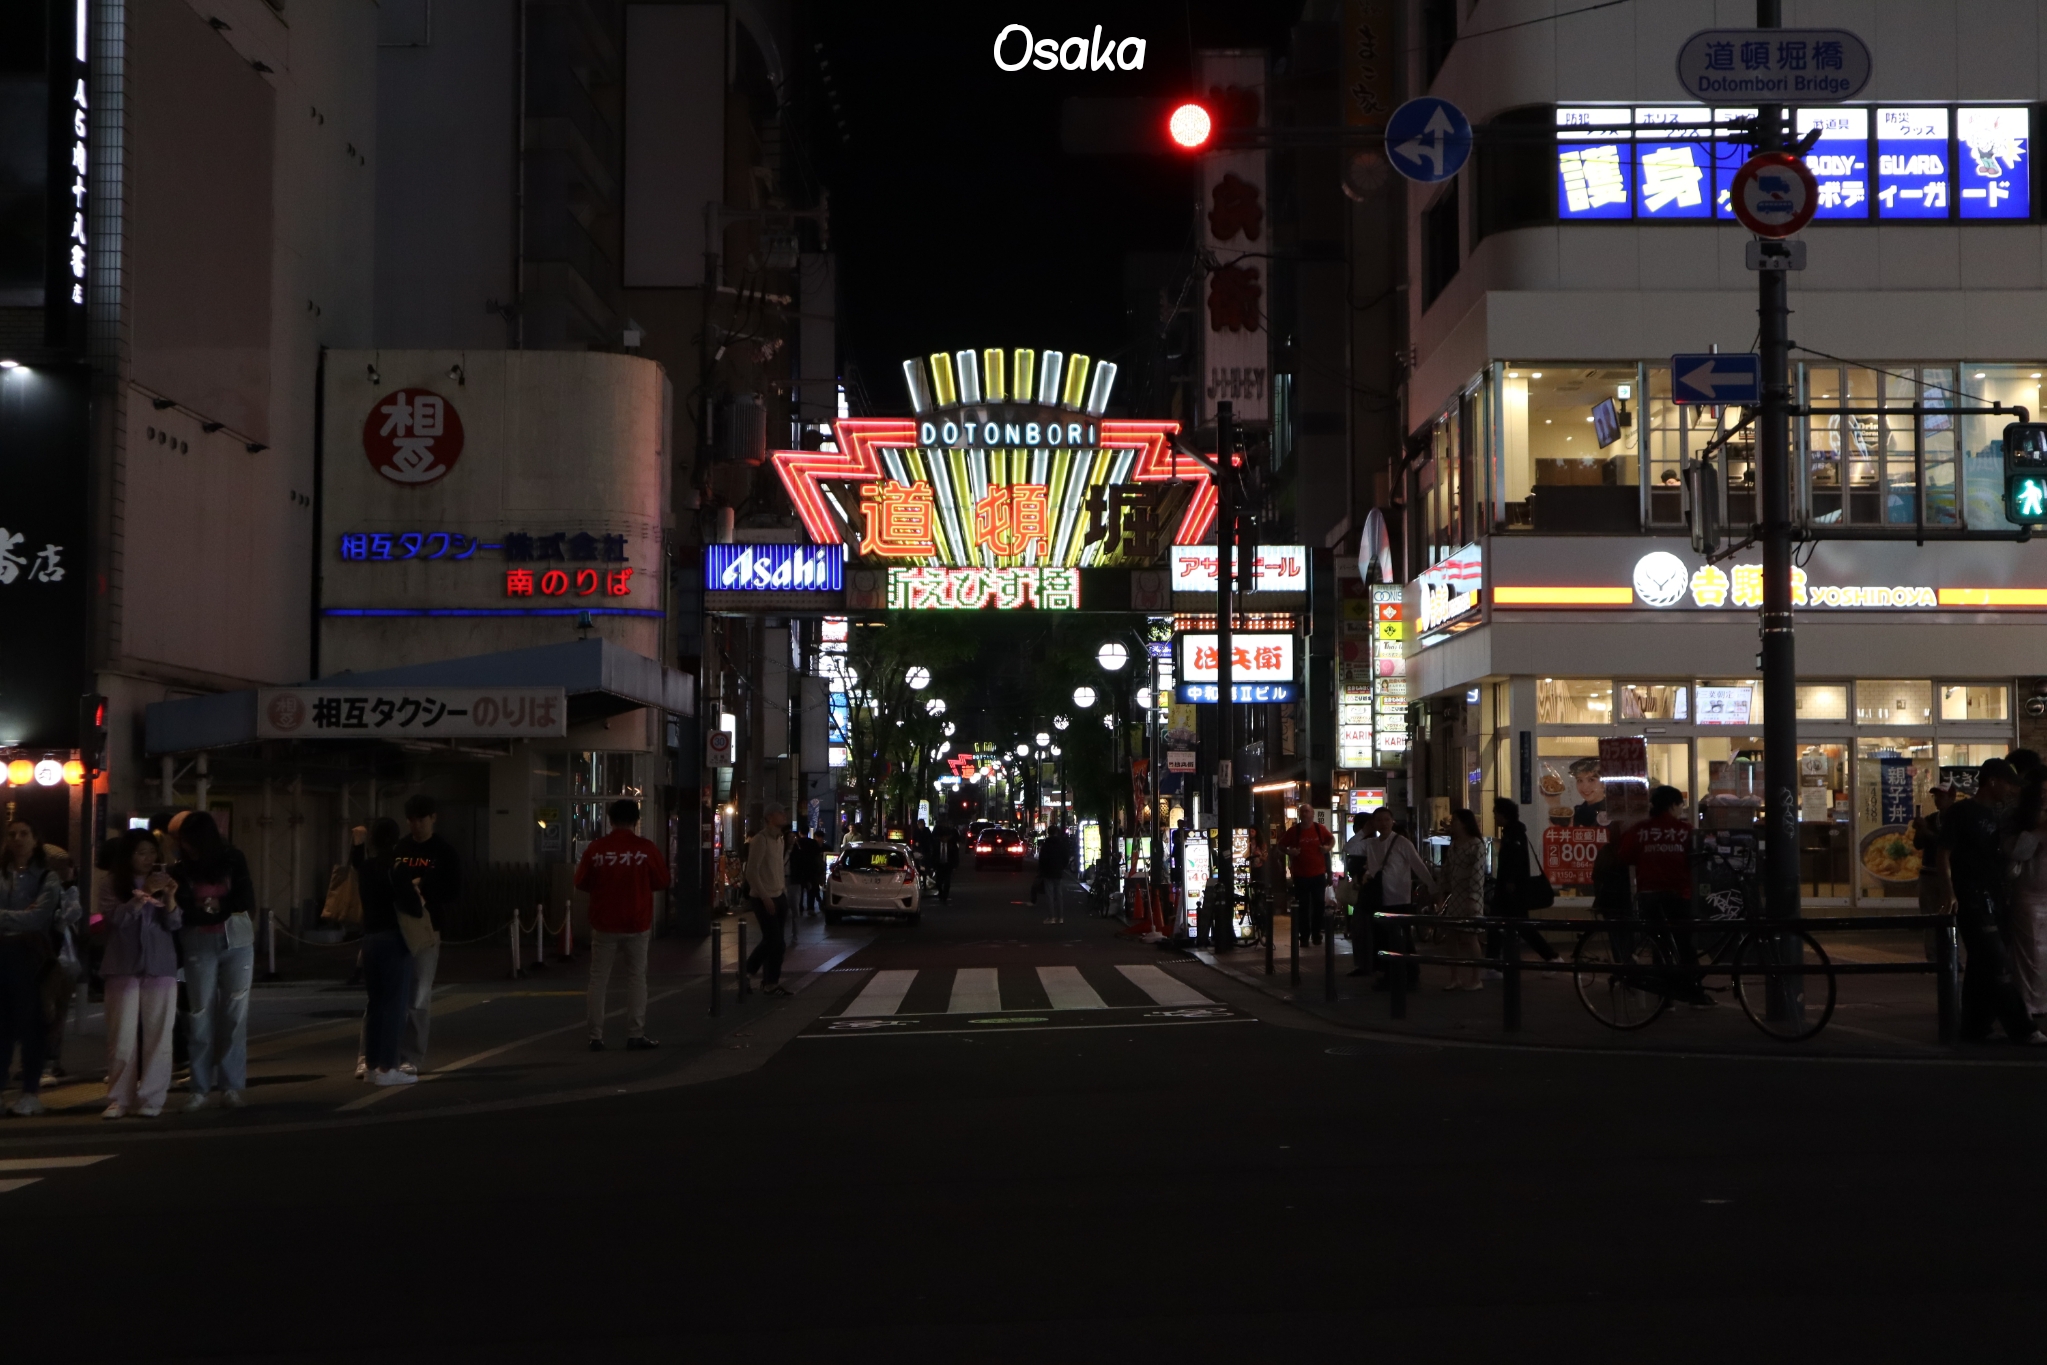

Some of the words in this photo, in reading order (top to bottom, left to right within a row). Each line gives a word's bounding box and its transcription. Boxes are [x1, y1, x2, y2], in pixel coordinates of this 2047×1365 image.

[1705, 41, 1843, 71] 道頓堀橋
[1698, 76, 1788, 92] Dotombori
[1794, 76, 1850, 93] Bridge
[1885, 111, 1910, 124] 防災
[1879, 154, 1945, 176] GUARD
[921, 421, 1096, 446] DOTONBORI
[860, 480, 1160, 557] 道頓堀
[340, 531, 630, 562] 相互タクシー株式会社
[721, 544, 827, 587] Asahi
[506, 567, 635, 597] 南のりば
[1811, 586, 1938, 607] YOSHINOYA
[714, 737, 725, 747] 30
[1888, 767, 1906, 823] 親子丼
[1546, 829, 1571, 842] 牛丼
[1636, 827, 1688, 843] カラオケ
[591, 850, 648, 868] カラオケ
[1561, 843, 1598, 862] 800
